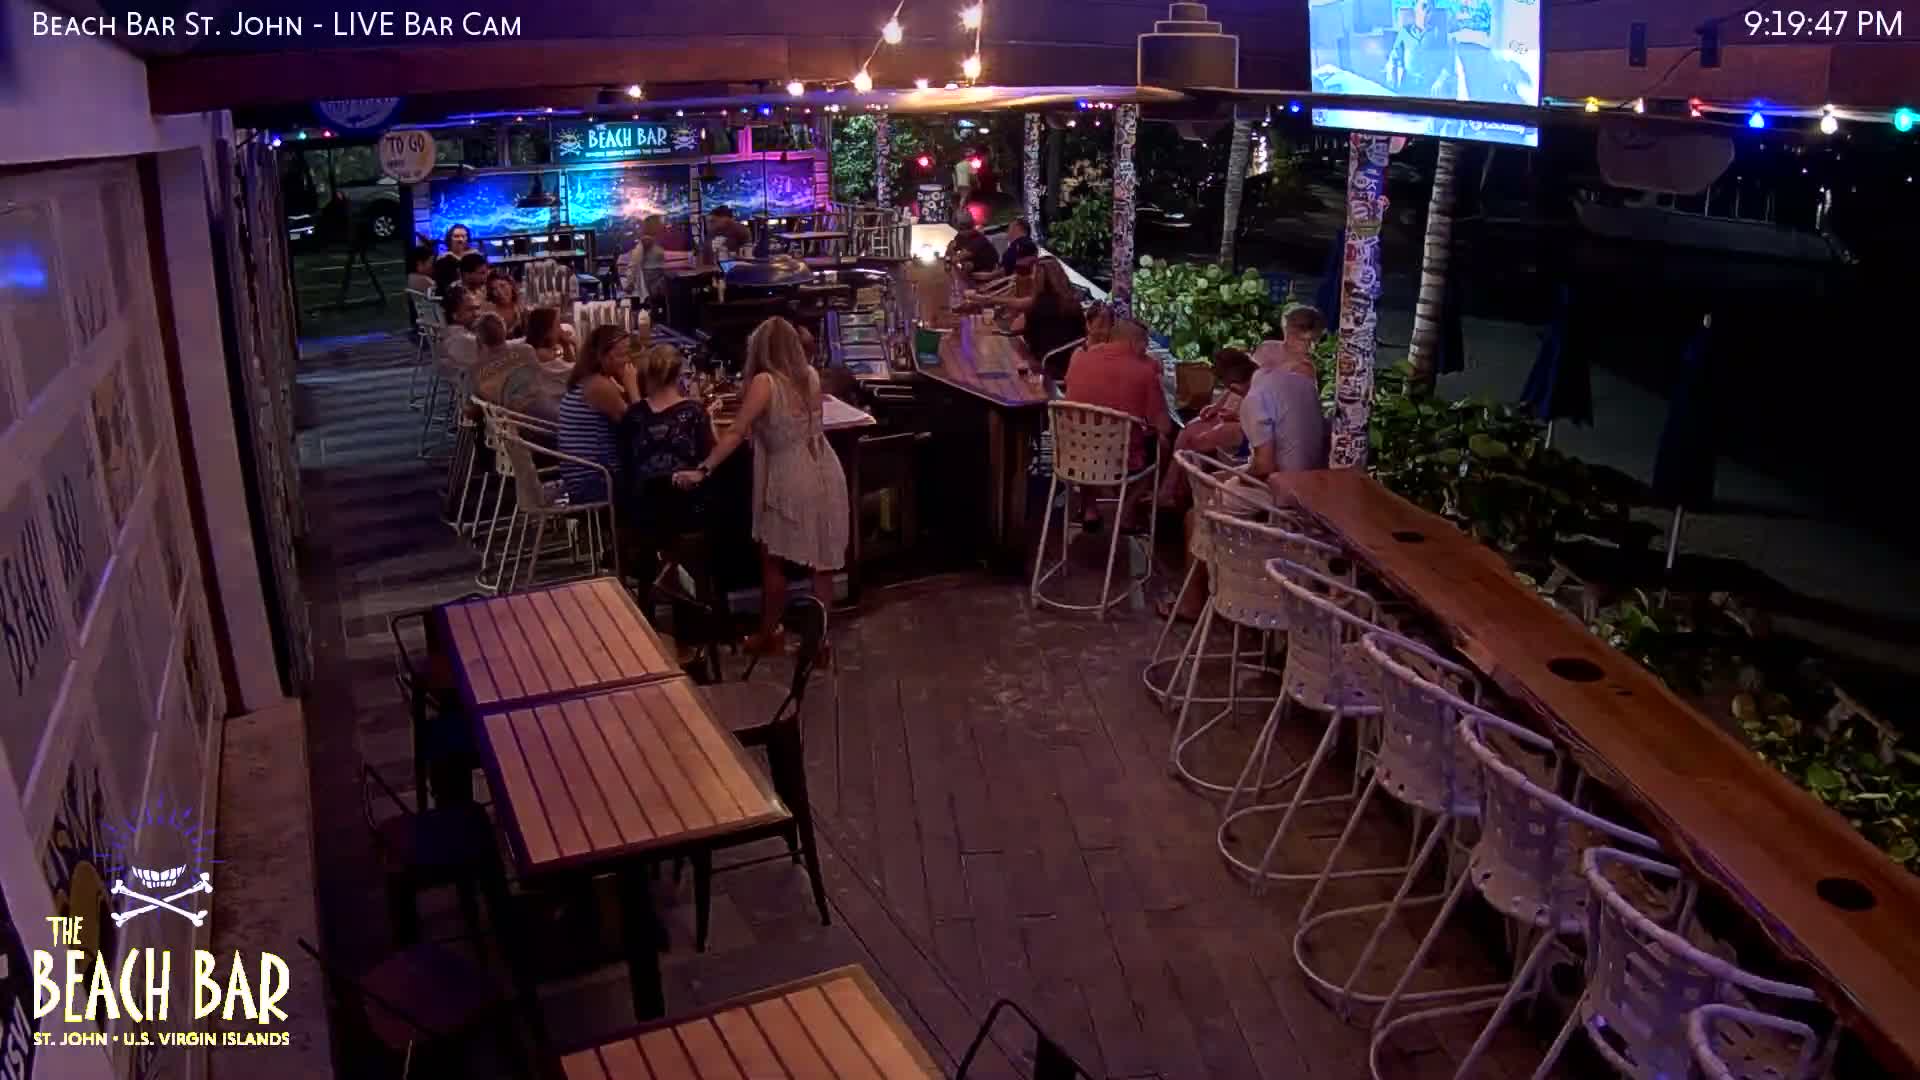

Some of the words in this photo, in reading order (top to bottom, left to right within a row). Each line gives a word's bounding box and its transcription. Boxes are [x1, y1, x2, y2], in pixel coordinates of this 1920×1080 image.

[386, 135, 405, 154] TO
[409, 134, 425, 153] GO
[588, 128, 632, 149] BEACH
[637, 127, 668, 146] BAR
